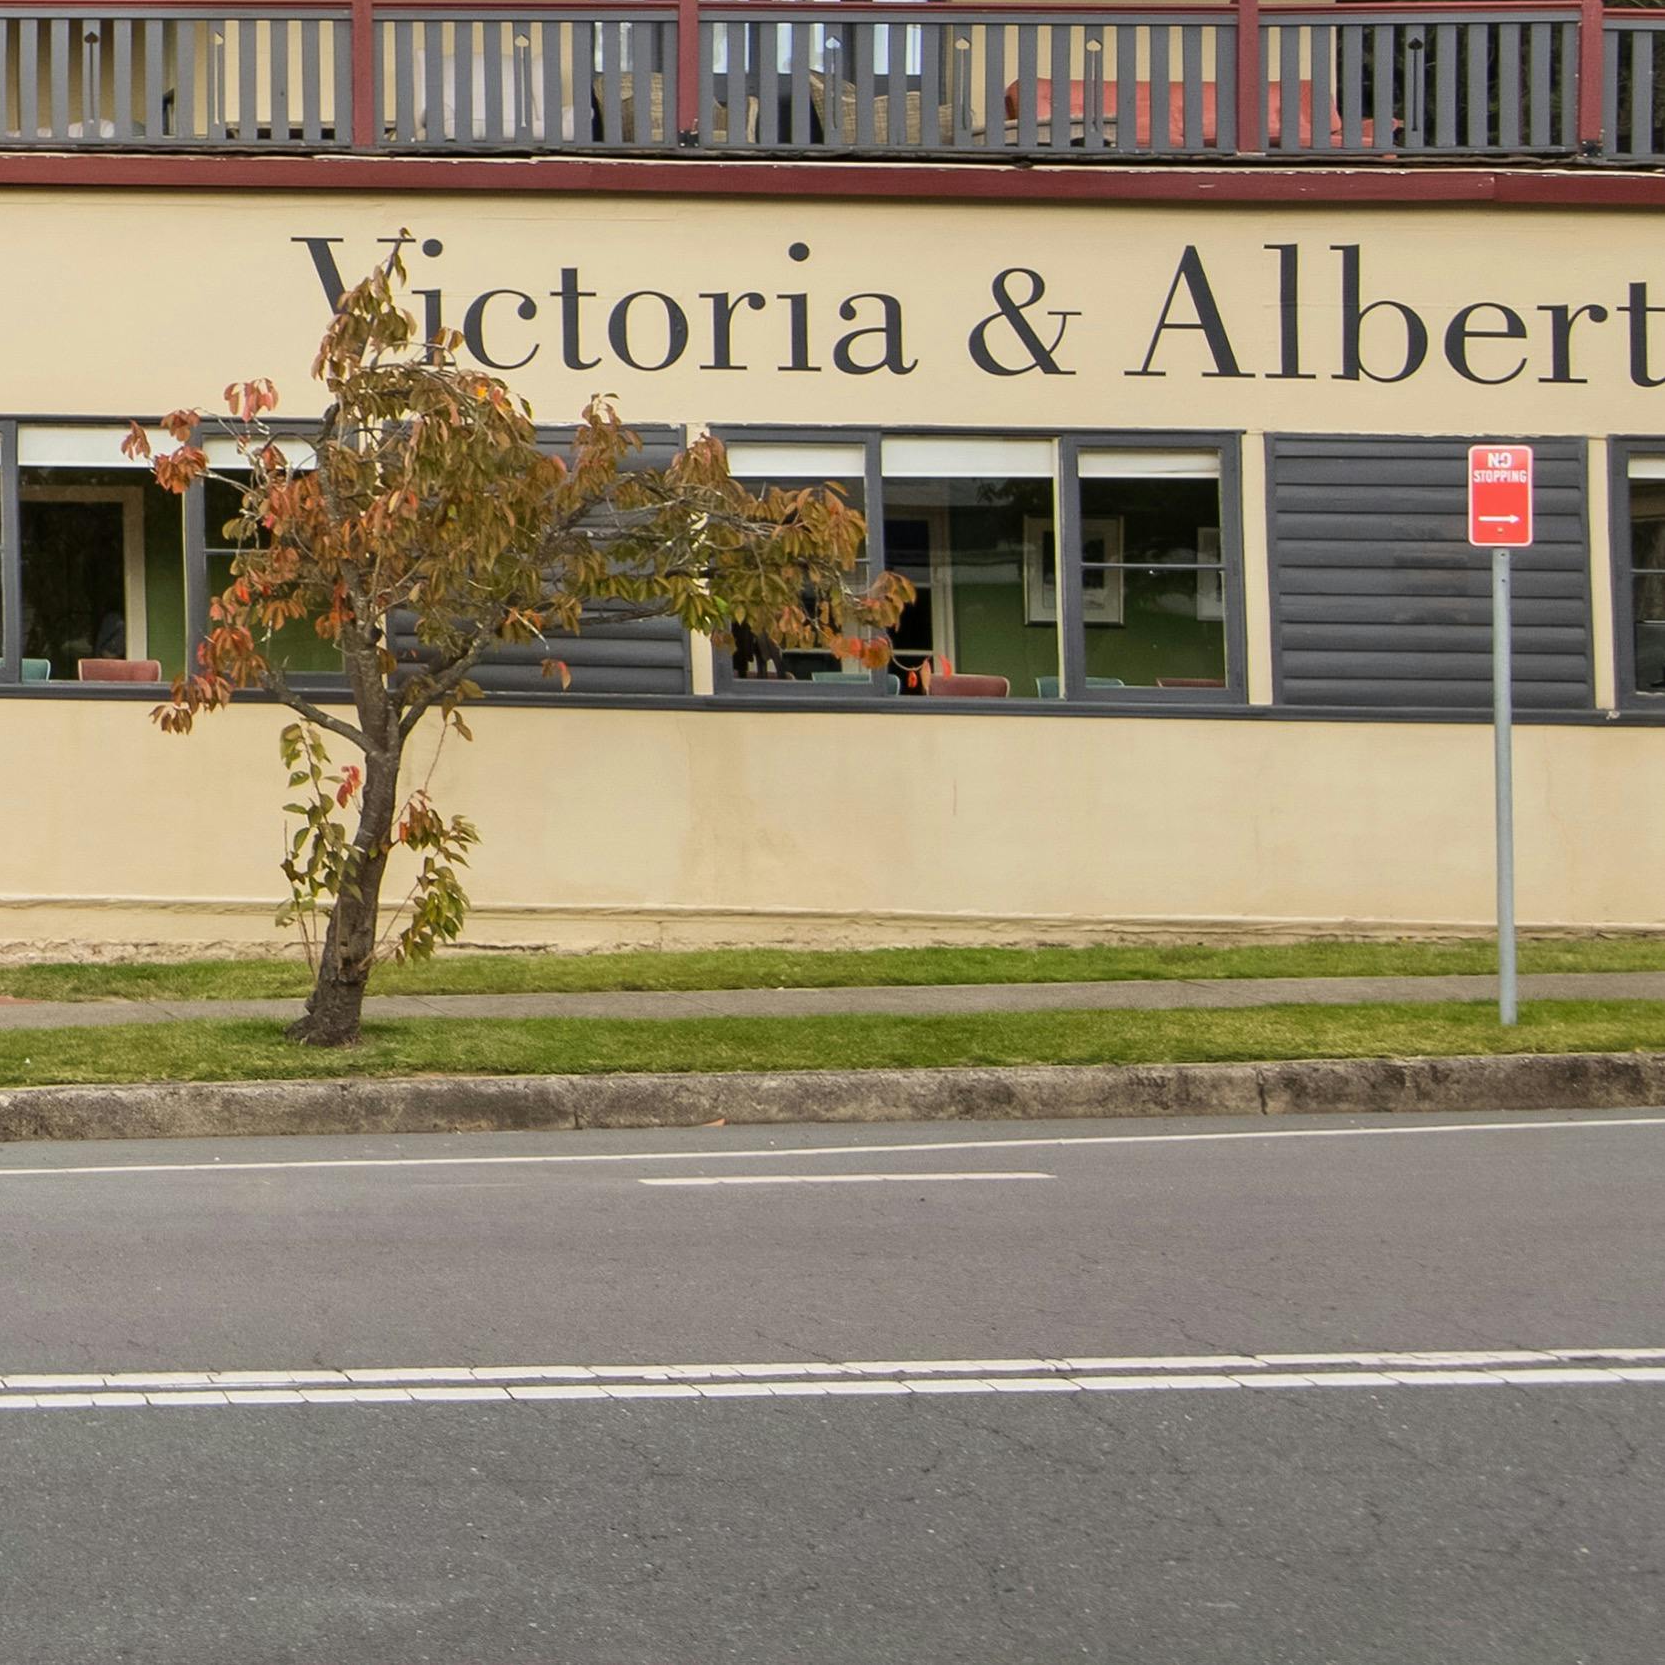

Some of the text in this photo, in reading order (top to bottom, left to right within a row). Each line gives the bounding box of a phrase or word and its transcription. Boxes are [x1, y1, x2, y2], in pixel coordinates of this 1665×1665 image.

[290, 238, 1665, 388] Victoria & Albert
[1487, 452, 1513, 468] NO
[1473, 470, 1528, 483] STOPPING
